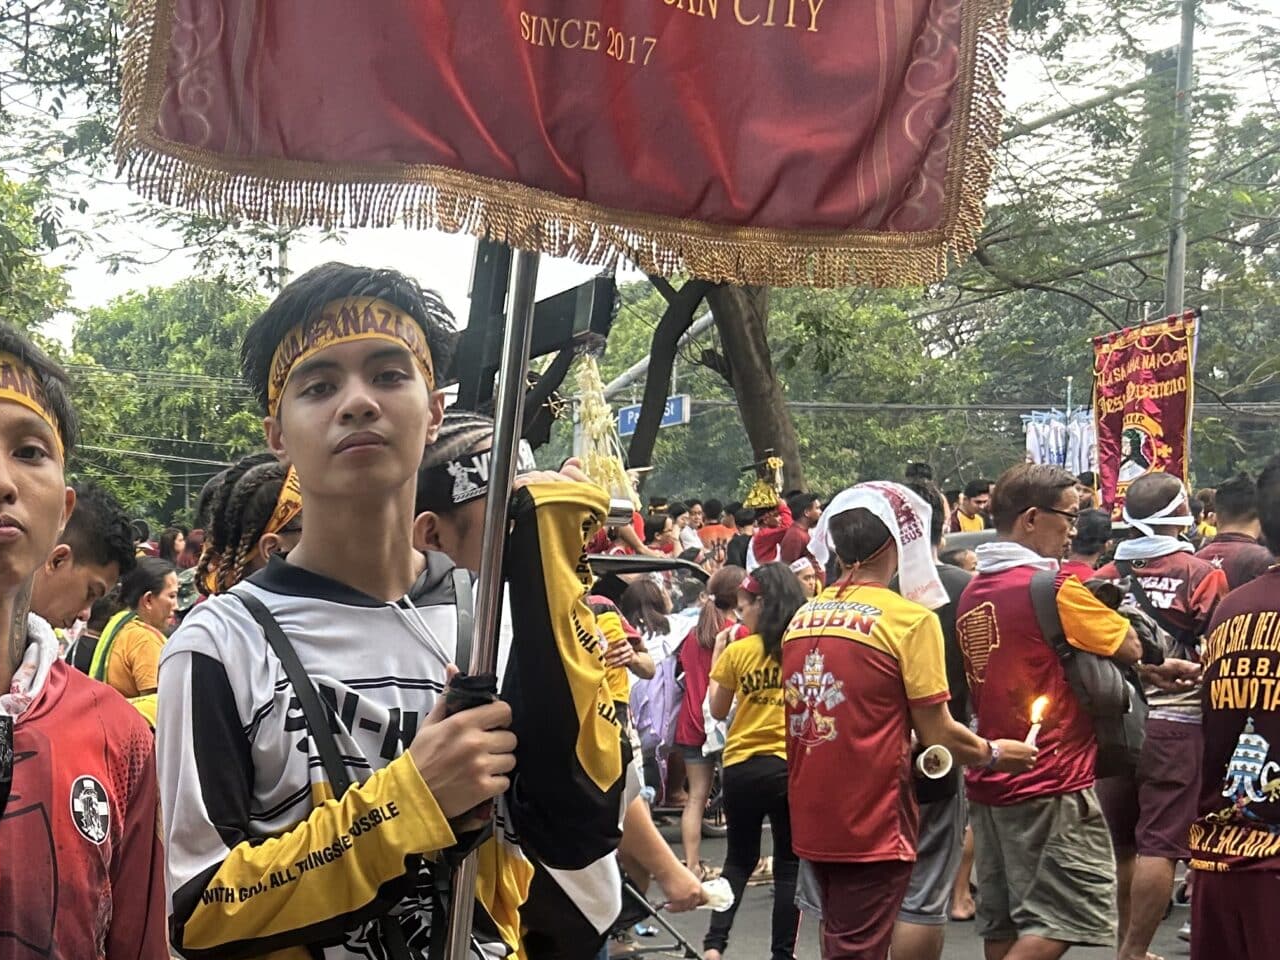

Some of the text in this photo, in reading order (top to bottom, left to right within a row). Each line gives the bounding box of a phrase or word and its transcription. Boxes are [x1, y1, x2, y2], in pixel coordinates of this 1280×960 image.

[520, 11, 658, 66] SINCE 2017
[200, 886, 235, 906] WITH
[270, 869, 297, 889] ALL
